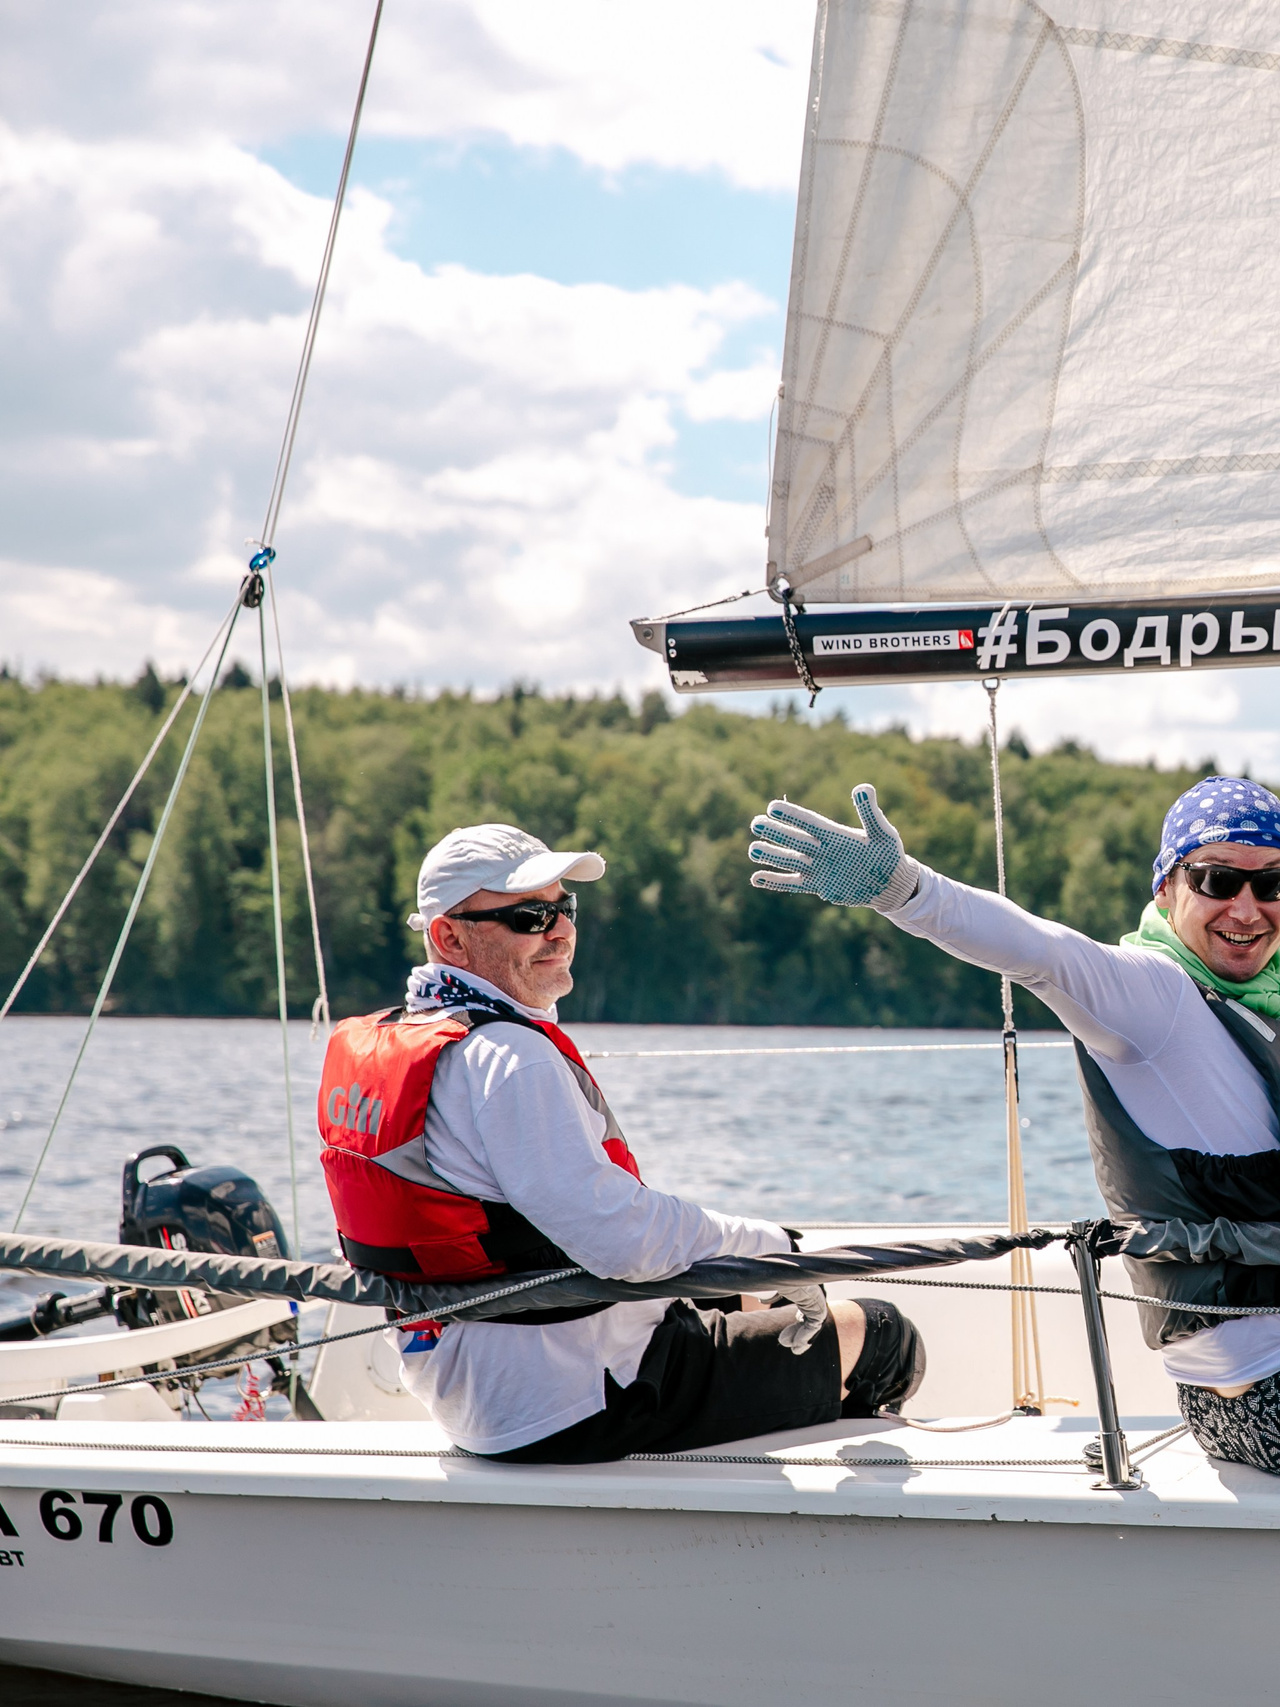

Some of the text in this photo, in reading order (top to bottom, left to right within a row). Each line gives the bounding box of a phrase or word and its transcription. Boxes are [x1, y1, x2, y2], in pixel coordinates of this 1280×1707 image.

[822, 635, 951, 650] WIND BROTHERS
[327, 1081, 383, 1136] Gill
[39, 1489, 175, 1547] 670
